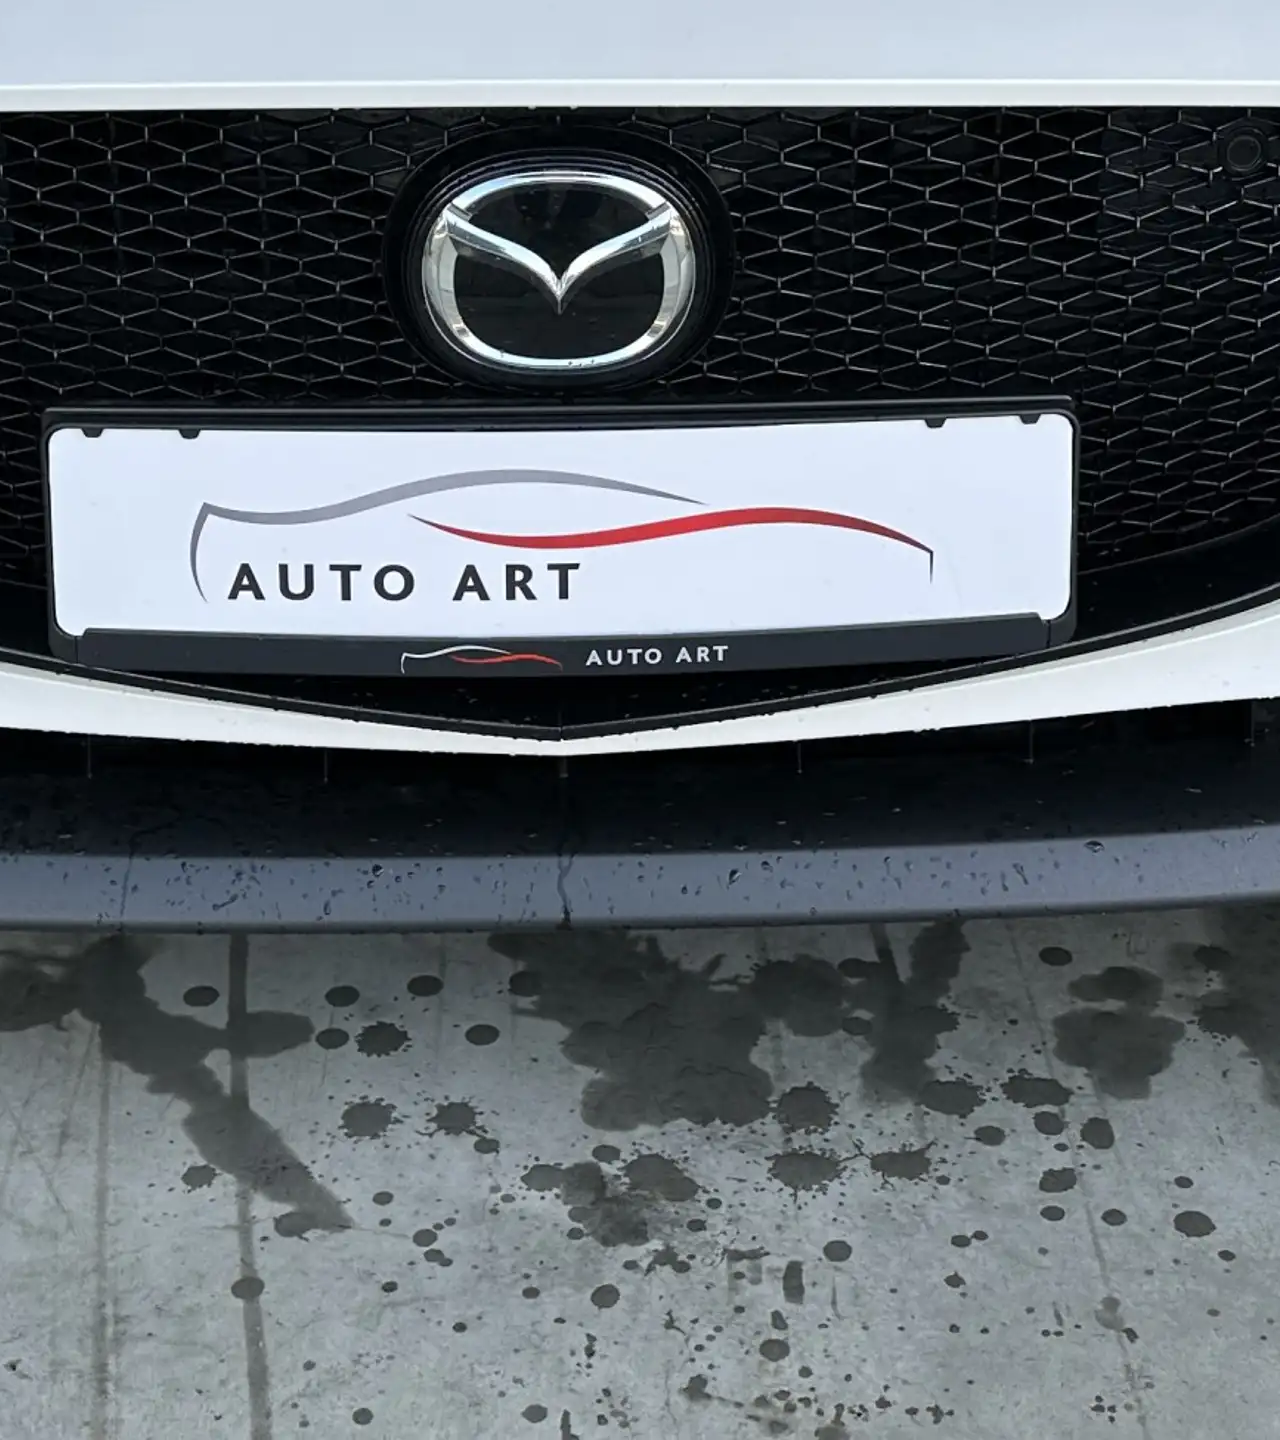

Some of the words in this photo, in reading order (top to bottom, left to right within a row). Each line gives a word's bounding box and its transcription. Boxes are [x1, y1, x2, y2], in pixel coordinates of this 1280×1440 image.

[228, 563, 415, 601] AUTO
[452, 563, 580, 601] ART
[585, 648, 663, 666] AUTO
[675, 645, 729, 663] ART
